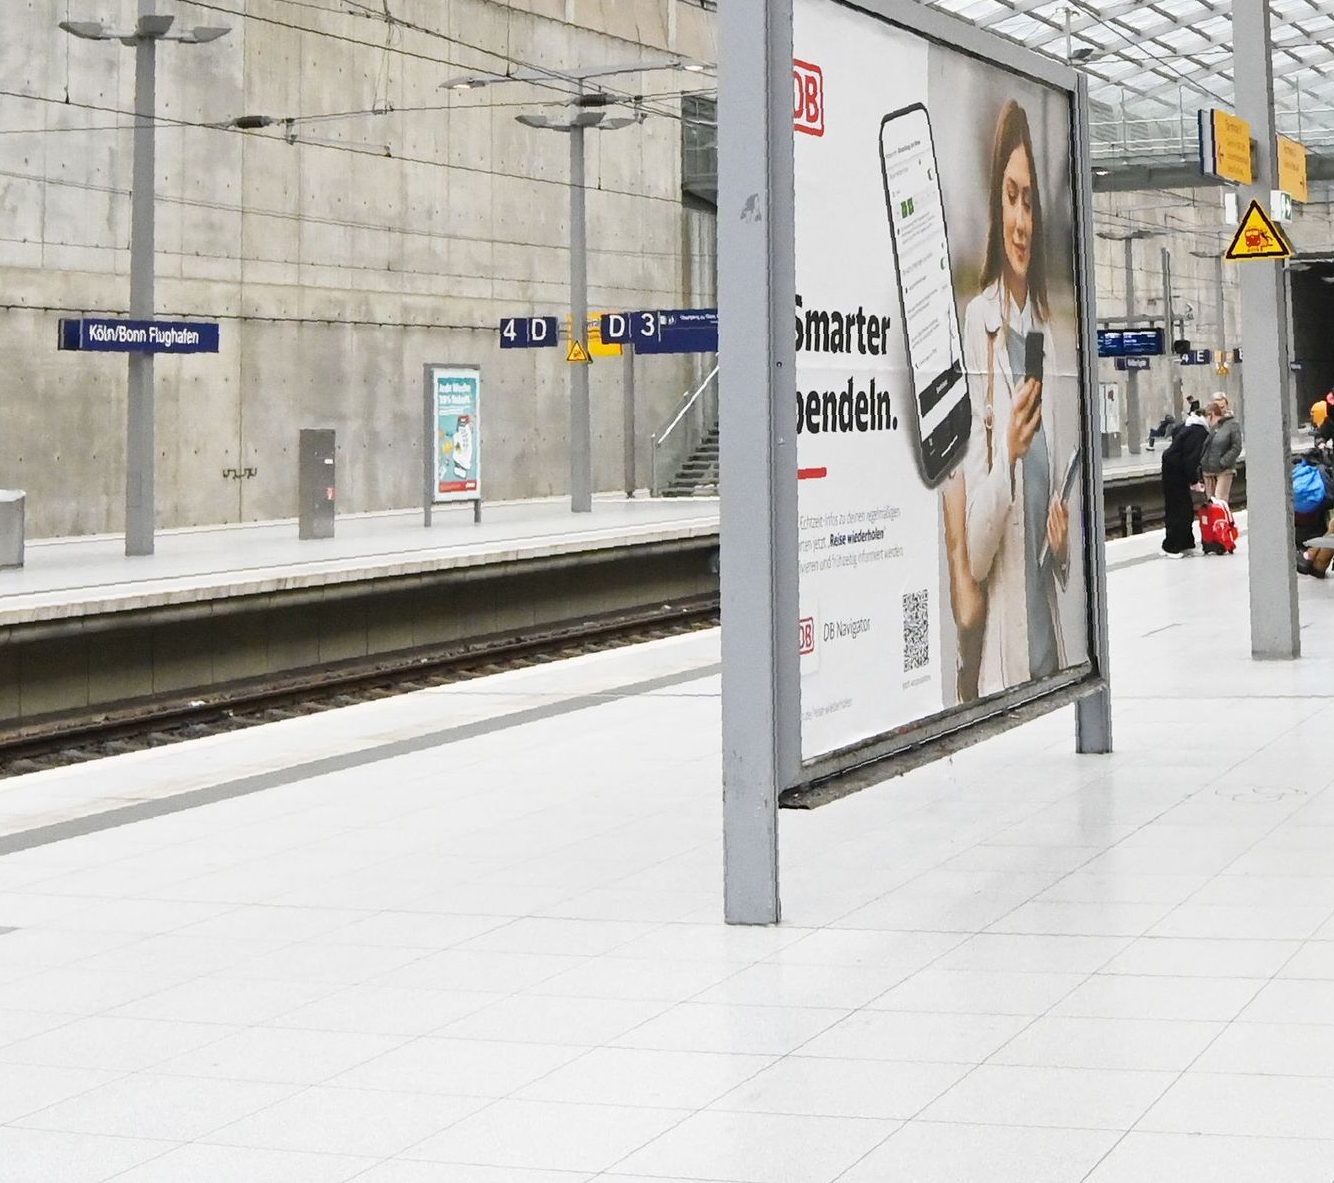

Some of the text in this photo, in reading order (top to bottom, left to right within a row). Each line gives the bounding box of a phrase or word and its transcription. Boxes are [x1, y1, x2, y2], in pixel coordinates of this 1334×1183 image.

[89, 324, 199, 348] Köln/Bonn Flughafen
[503, 318, 547, 342] 4 D
[609, 314, 626, 338] D
[640, 312, 655, 337] 3
[795, 294, 891, 356] Smarter
[1196, 350, 1205, 363] E
[823, 617, 871, 642] DB Navigator
